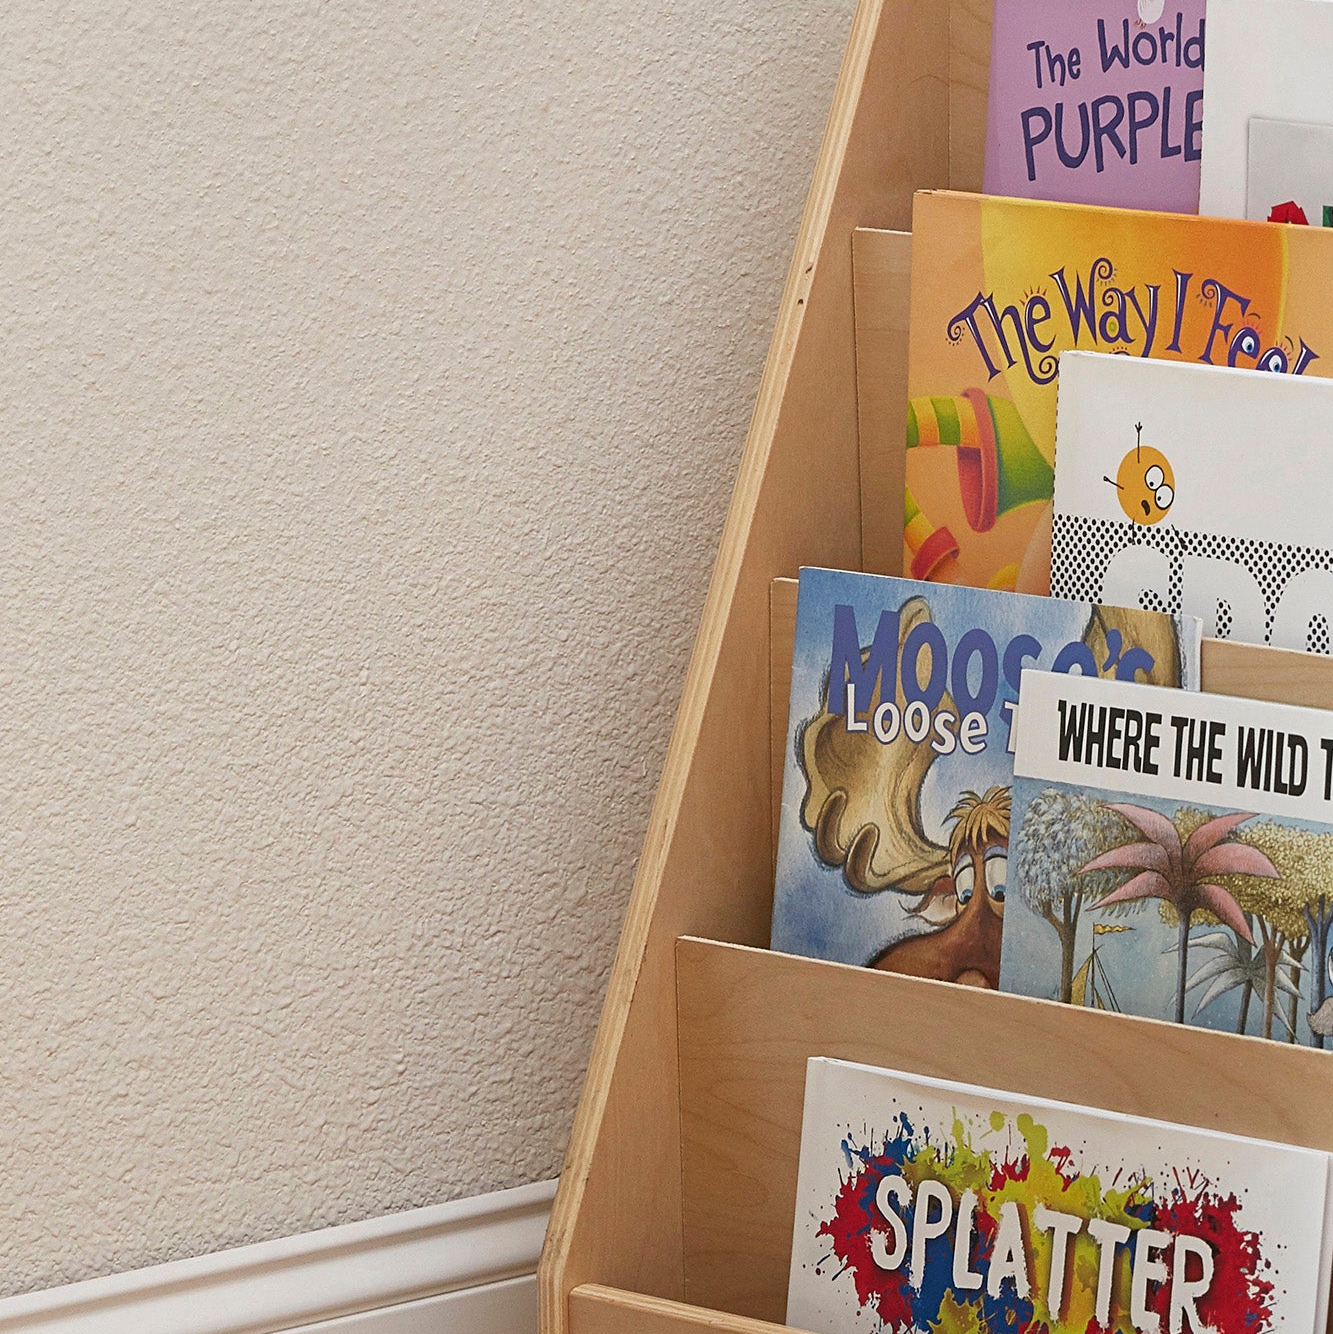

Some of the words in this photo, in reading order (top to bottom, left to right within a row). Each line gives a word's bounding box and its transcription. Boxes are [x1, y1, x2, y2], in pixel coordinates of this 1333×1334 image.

[1026, 40, 1081, 89] The
[1096, 11, 1206, 73] World
[1020, 85, 1204, 182] PURPLE
[946, 291, 1061, 385] The
[1049, 257, 1162, 358] Way
[1165, 268, 1194, 354] I
[846, 682, 989, 755] Loose
[1058, 698, 1163, 777] WHERE
[1170, 714, 1223, 785] THE
[1235, 725, 1310, 798] WILD
